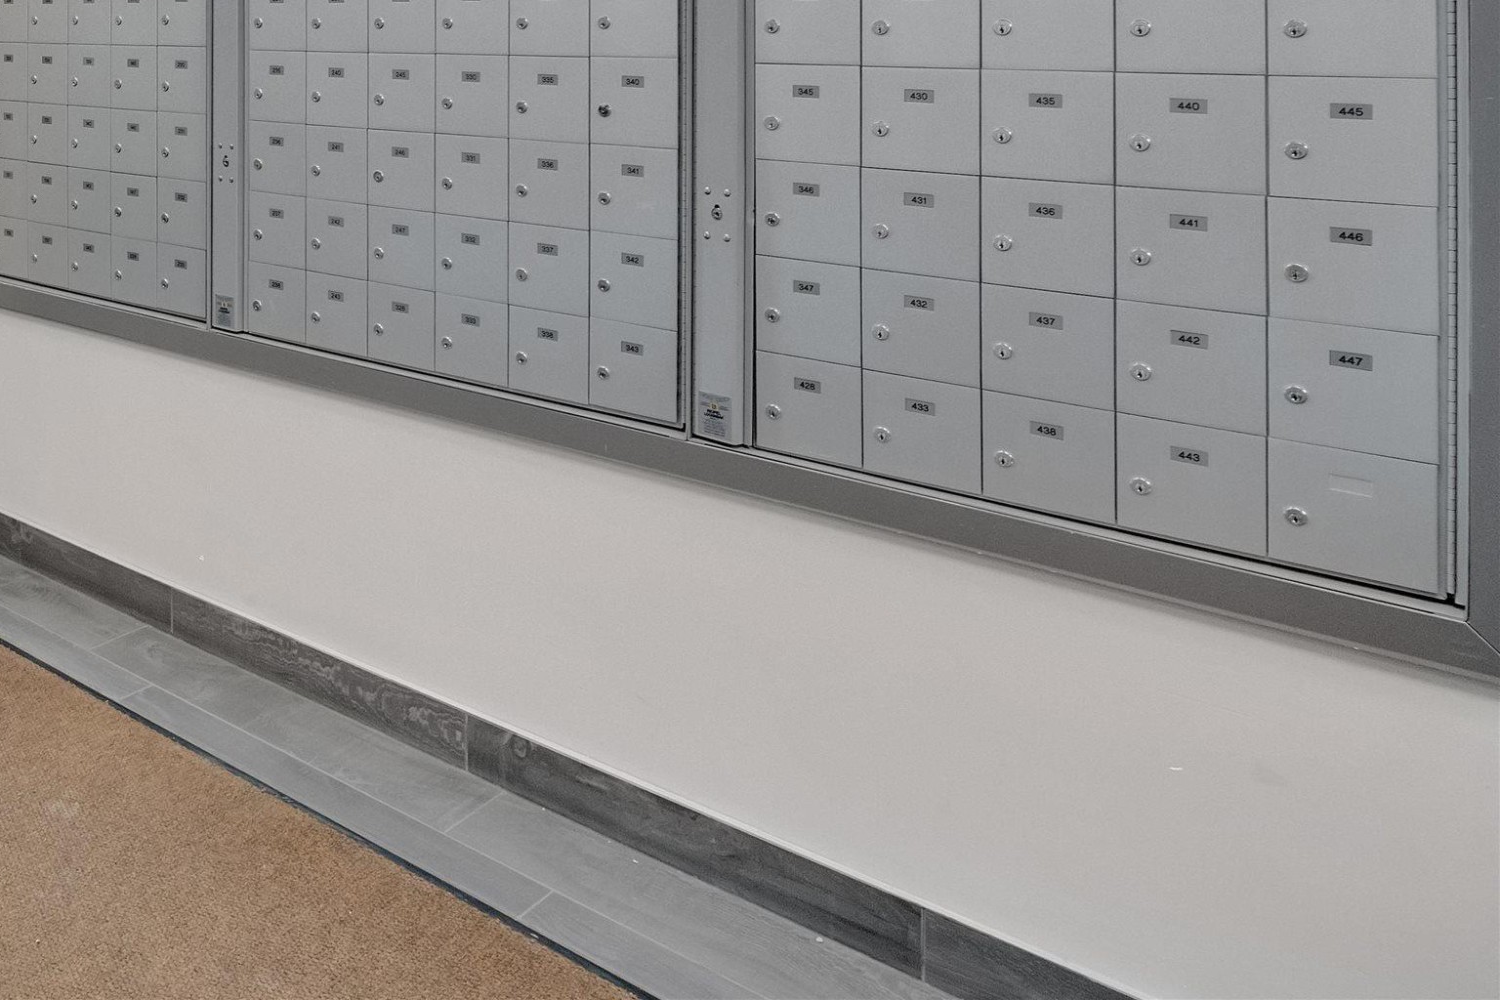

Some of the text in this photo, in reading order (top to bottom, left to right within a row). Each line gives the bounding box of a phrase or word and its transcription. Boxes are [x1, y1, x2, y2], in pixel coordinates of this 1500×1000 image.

[626, 78, 640, 86] 340
[797, 87, 814, 96] 345
[910, 92, 928, 101] 430
[1035, 96, 1056, 106] 435
[1177, 102, 1200, 111] 440
[1338, 107, 1364, 117] 445
[627, 166, 639, 175] 341
[798, 185, 814, 194] 346
[911, 196, 927, 205] 431
[1035, 206, 1056, 216] 436
[1179, 218, 1198, 228] 441
[1338, 231, 1364, 242] 446
[625, 255, 640, 264] 342
[798, 283, 814, 292] 347
[910, 299, 928, 309] 432
[1036, 316, 1056, 326] 437
[1178, 334, 1201, 346] 442
[625, 344, 639, 353] 343
[1338, 355, 1363, 366] 447
[799, 381, 816, 391] 428
[911, 402, 929, 412] 433
[1037, 425, 1057, 436] 438
[1178, 451, 1200, 463] 443
